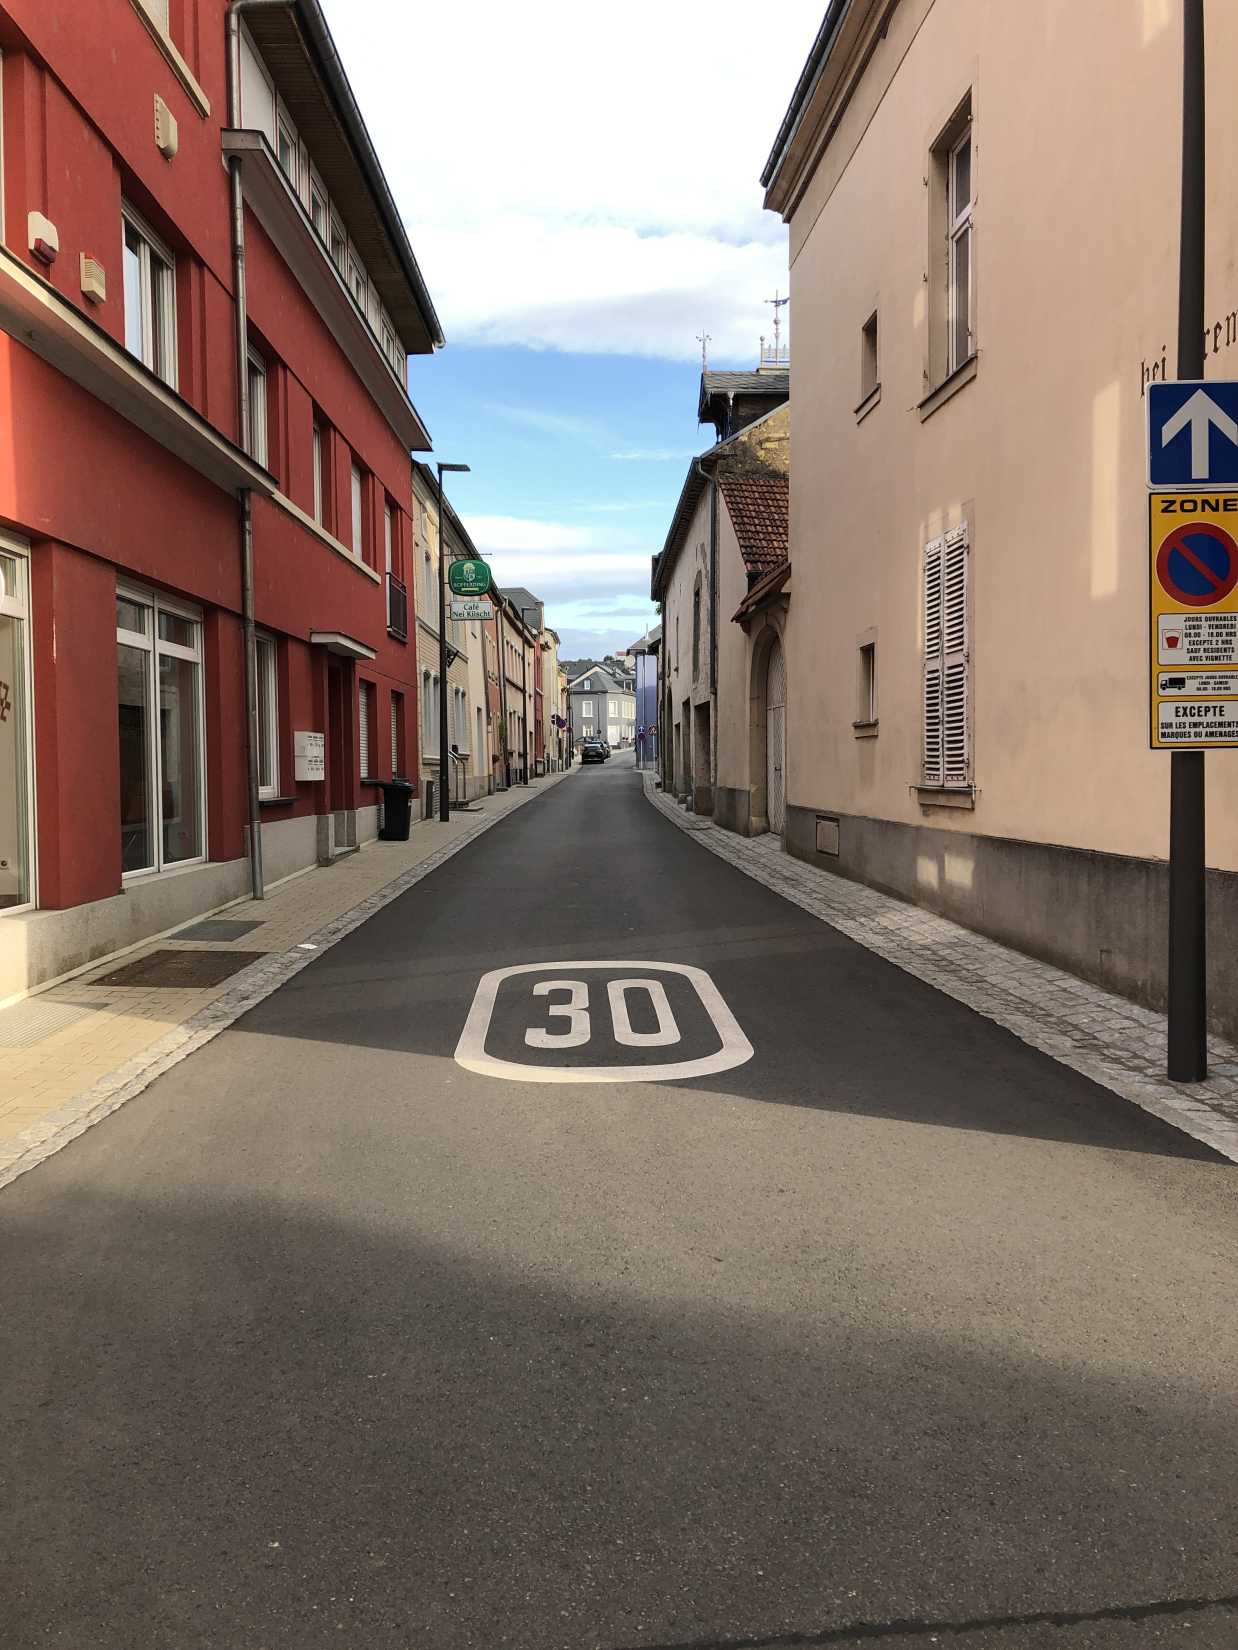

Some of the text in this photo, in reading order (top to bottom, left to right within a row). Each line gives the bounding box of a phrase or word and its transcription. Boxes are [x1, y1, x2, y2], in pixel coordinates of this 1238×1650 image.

[1160, 498, 1238, 514] ZONE
[463, 602, 479, 611] Café
[1175, 705, 1225, 718] EXCEPTE
[1160, 731, 1191, 739] MARQUES
[524, 978, 681, 1049] 30
